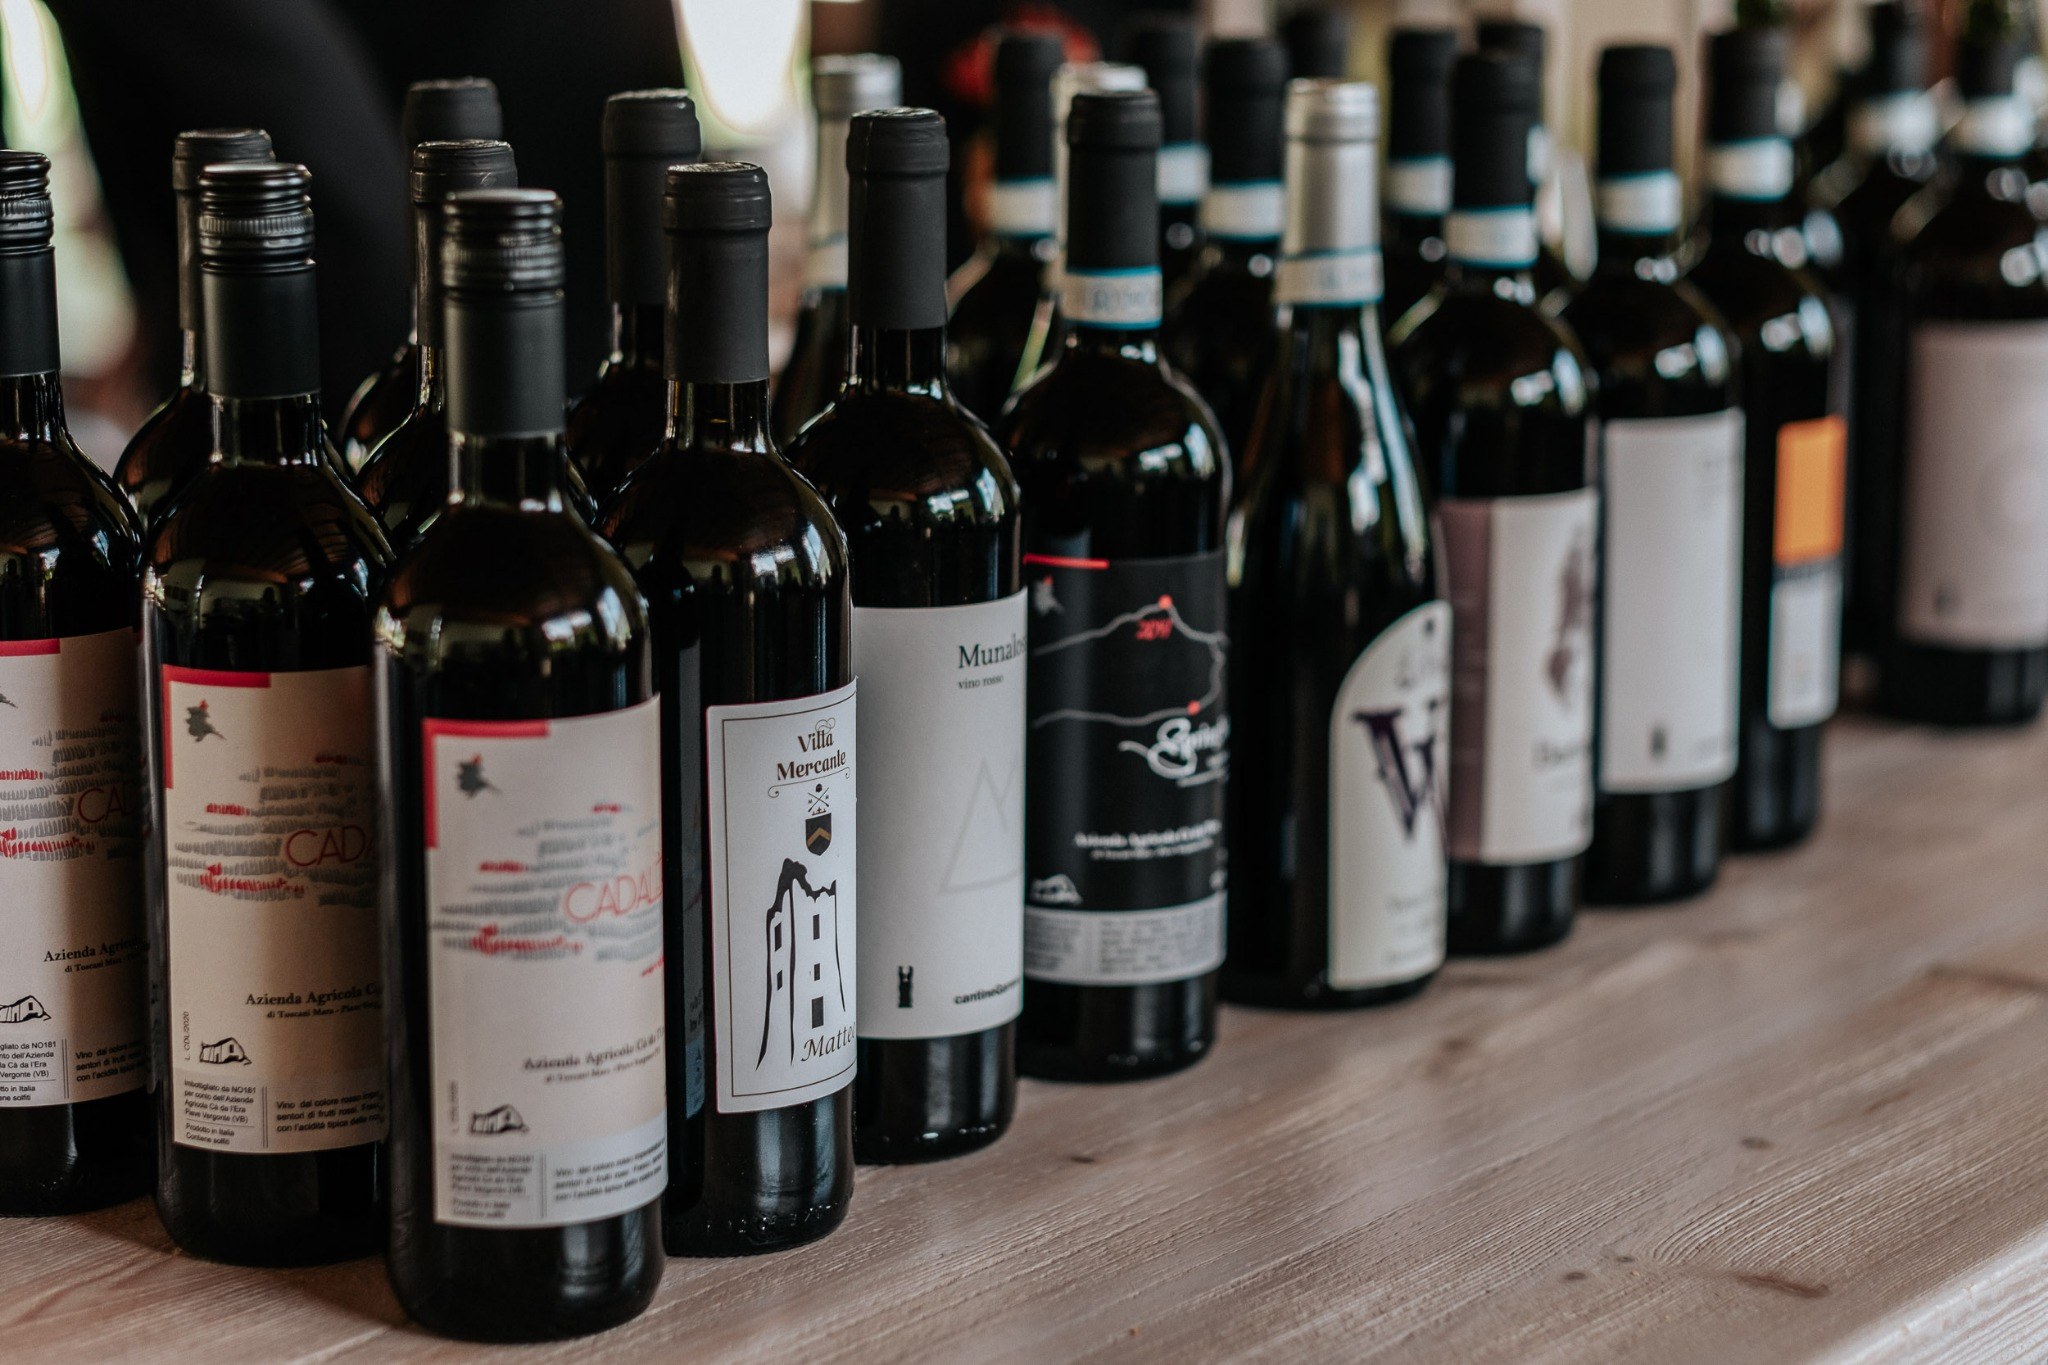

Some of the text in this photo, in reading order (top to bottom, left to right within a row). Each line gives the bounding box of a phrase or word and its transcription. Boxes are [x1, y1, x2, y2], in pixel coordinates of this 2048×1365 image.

[958, 674, 1004, 690] vino rosso
[798, 729, 835, 752] Villa
[777, 749, 846, 781] Mercante
[44, 945, 96, 963] Azienda
[246, 992, 302, 1005] Azienda
[306, 985, 362, 1006] Agricola
[31, 1041, 56, 1049] NO181
[75, 1050, 93, 1060] Vino
[19, 1061, 29, 1069] da
[33, 1070, 49, 1078] (VB)
[76, 1073, 91, 1082] con
[184, 1090, 194, 1098] per
[231, 1086, 256, 1094] NO181
[276, 1100, 296, 1110] Vino
[300, 1099, 312, 1109] dal
[314, 1097, 339, 1107] colore
[232, 1114, 249, 1124] (VB)
[276, 1111, 305, 1121] sentori
[308, 1110, 315, 1119] di
[276, 1125, 292, 1133] con
